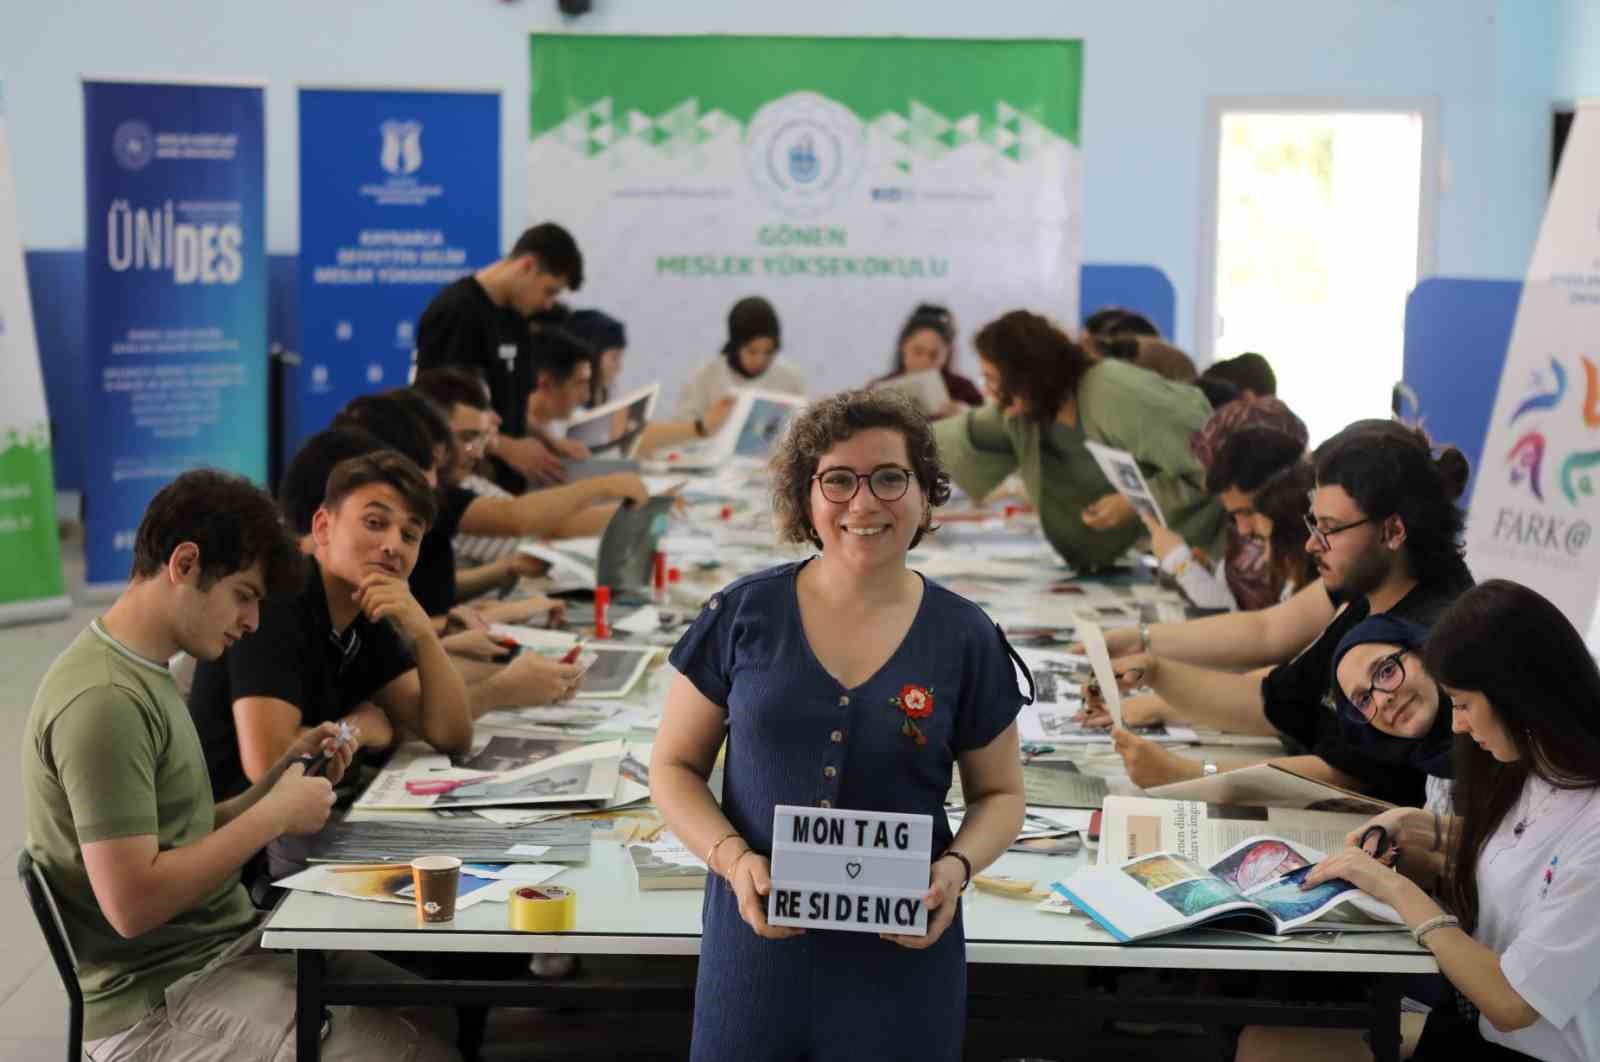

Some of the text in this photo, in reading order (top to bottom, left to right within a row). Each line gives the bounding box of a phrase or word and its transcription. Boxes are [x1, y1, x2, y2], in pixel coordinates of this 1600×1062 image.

[757, 223, 848, 248] GÖNEN
[656, 255, 754, 277] MESLEK
[775, 889, 921, 926] RESIDENCY
